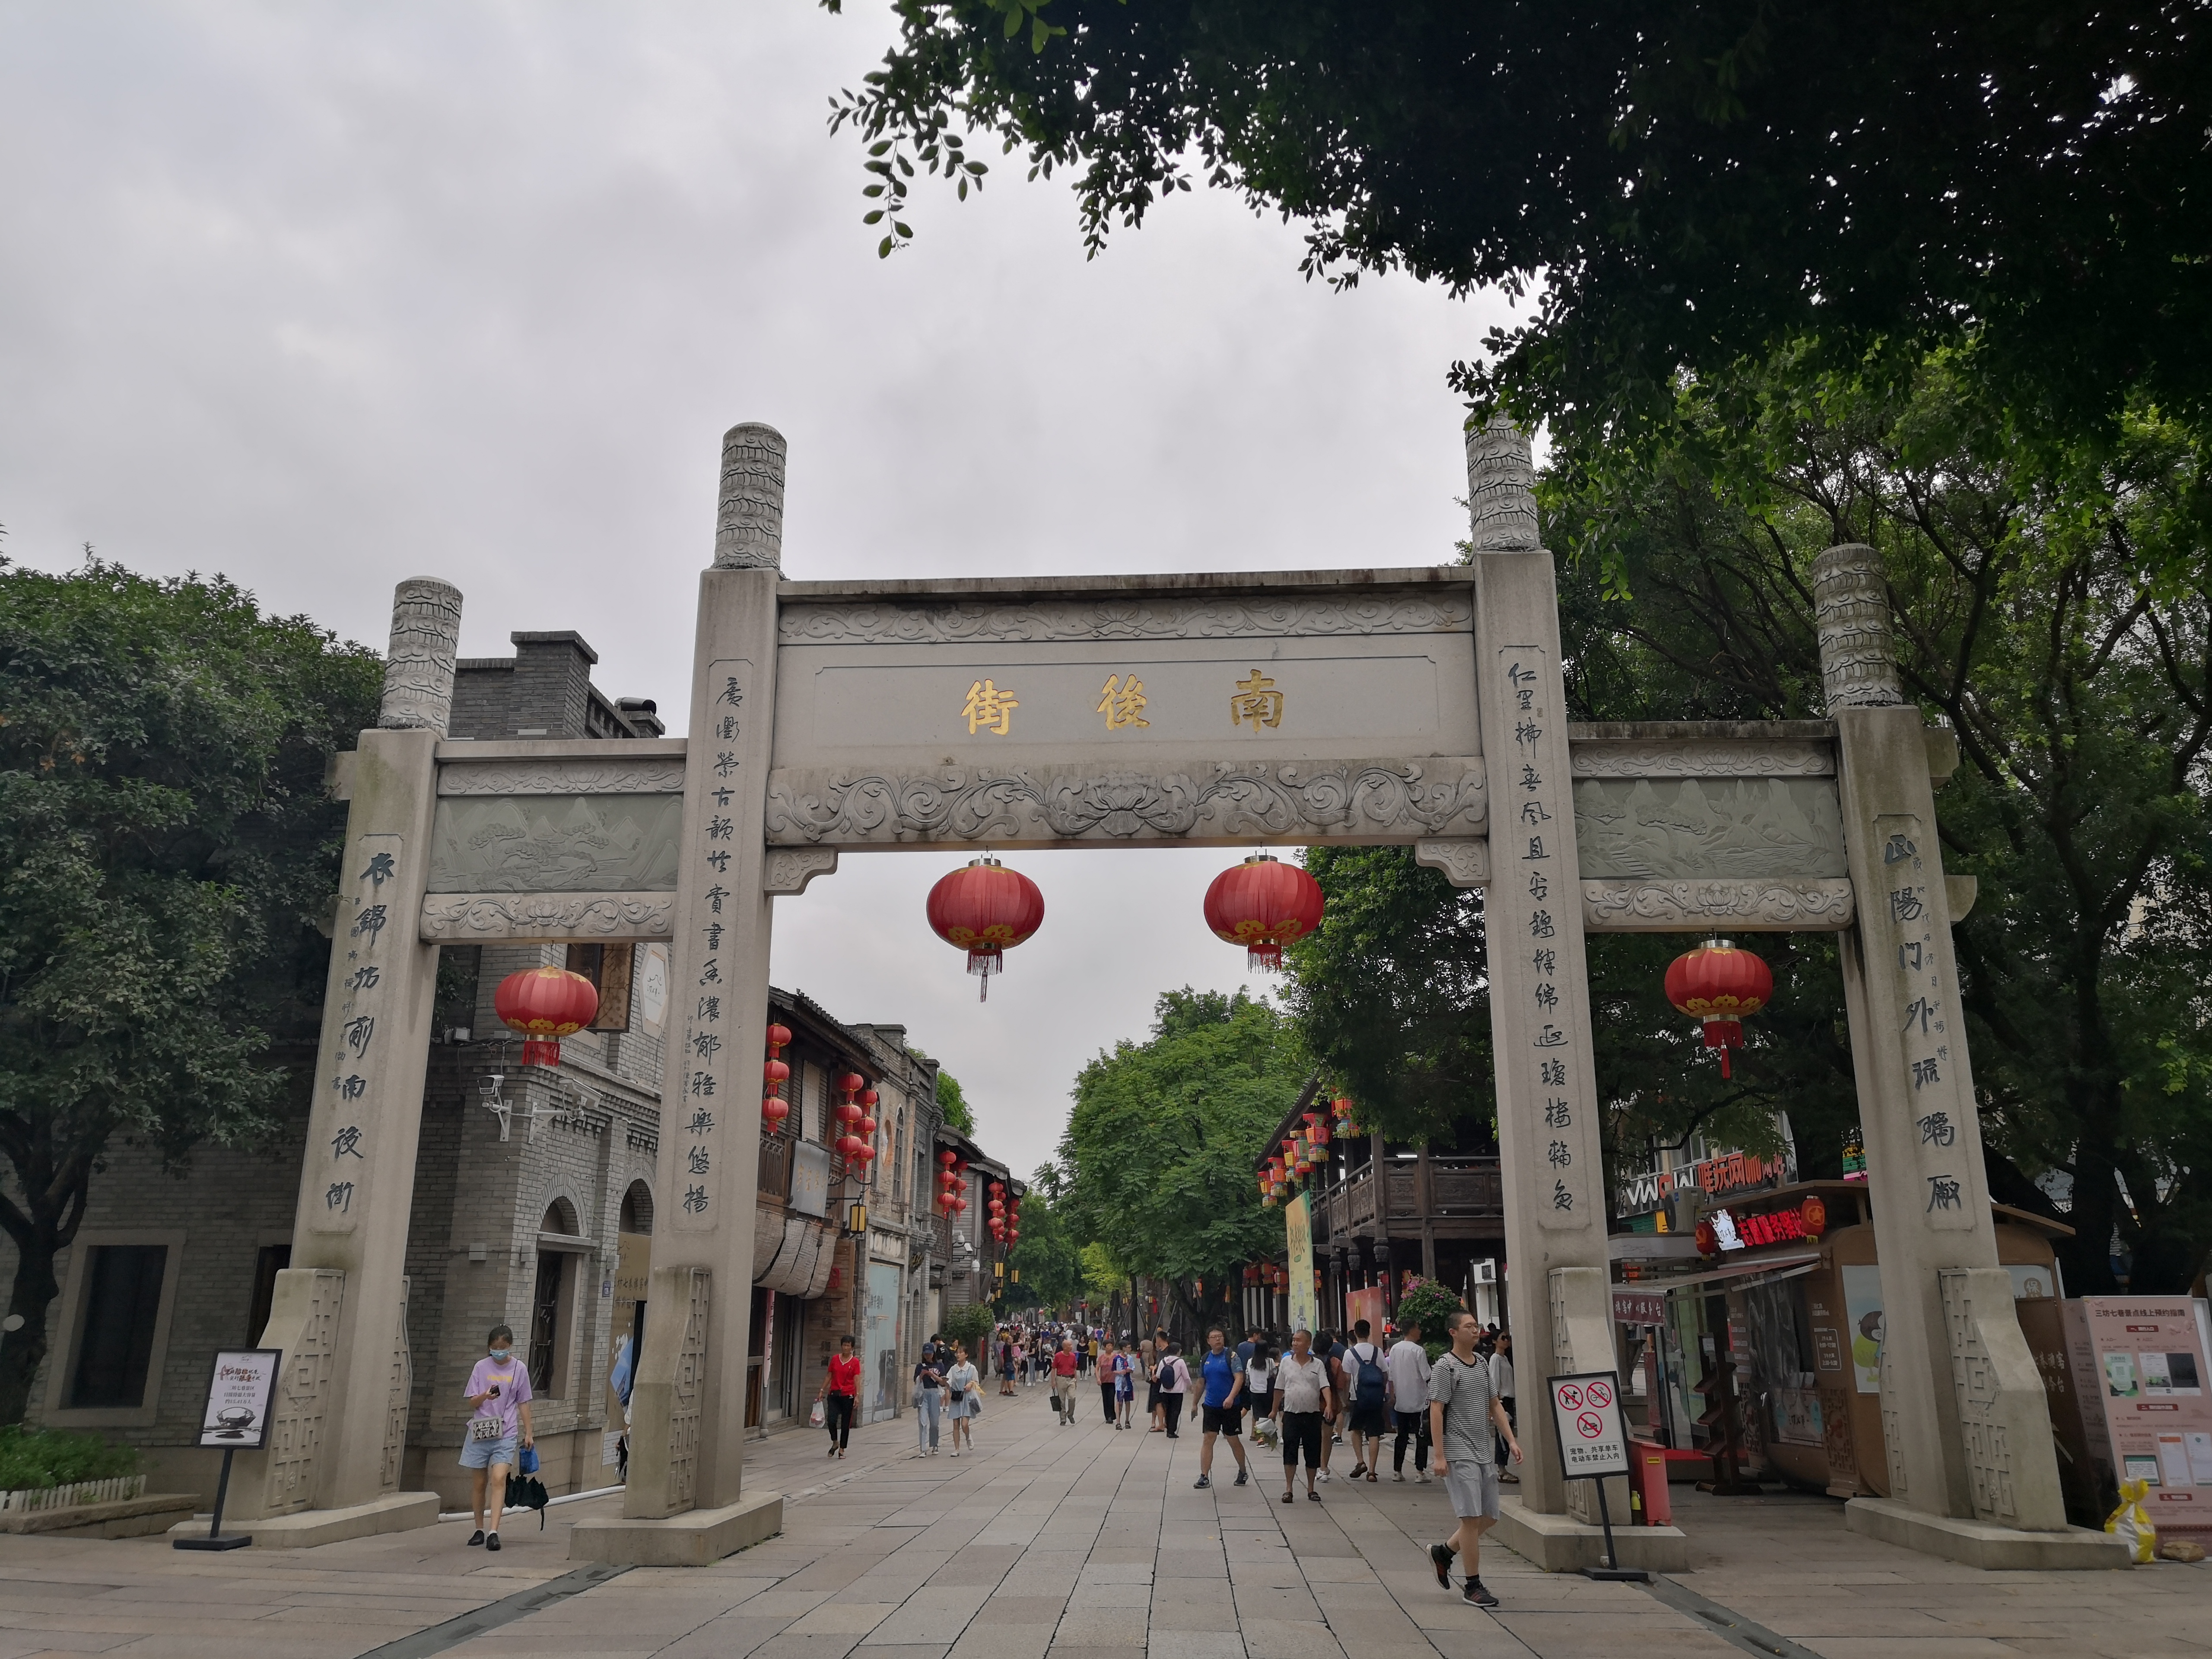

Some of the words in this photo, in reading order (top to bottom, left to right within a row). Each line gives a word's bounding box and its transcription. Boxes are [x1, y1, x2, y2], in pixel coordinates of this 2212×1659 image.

[2095, 1309, 2186, 1317] 三坊七巷景点线上预约指南
[1570, 1444, 1618, 1455] 宠物、共享单车
[1571, 1452, 1620, 1463] 电动车禁止入内
